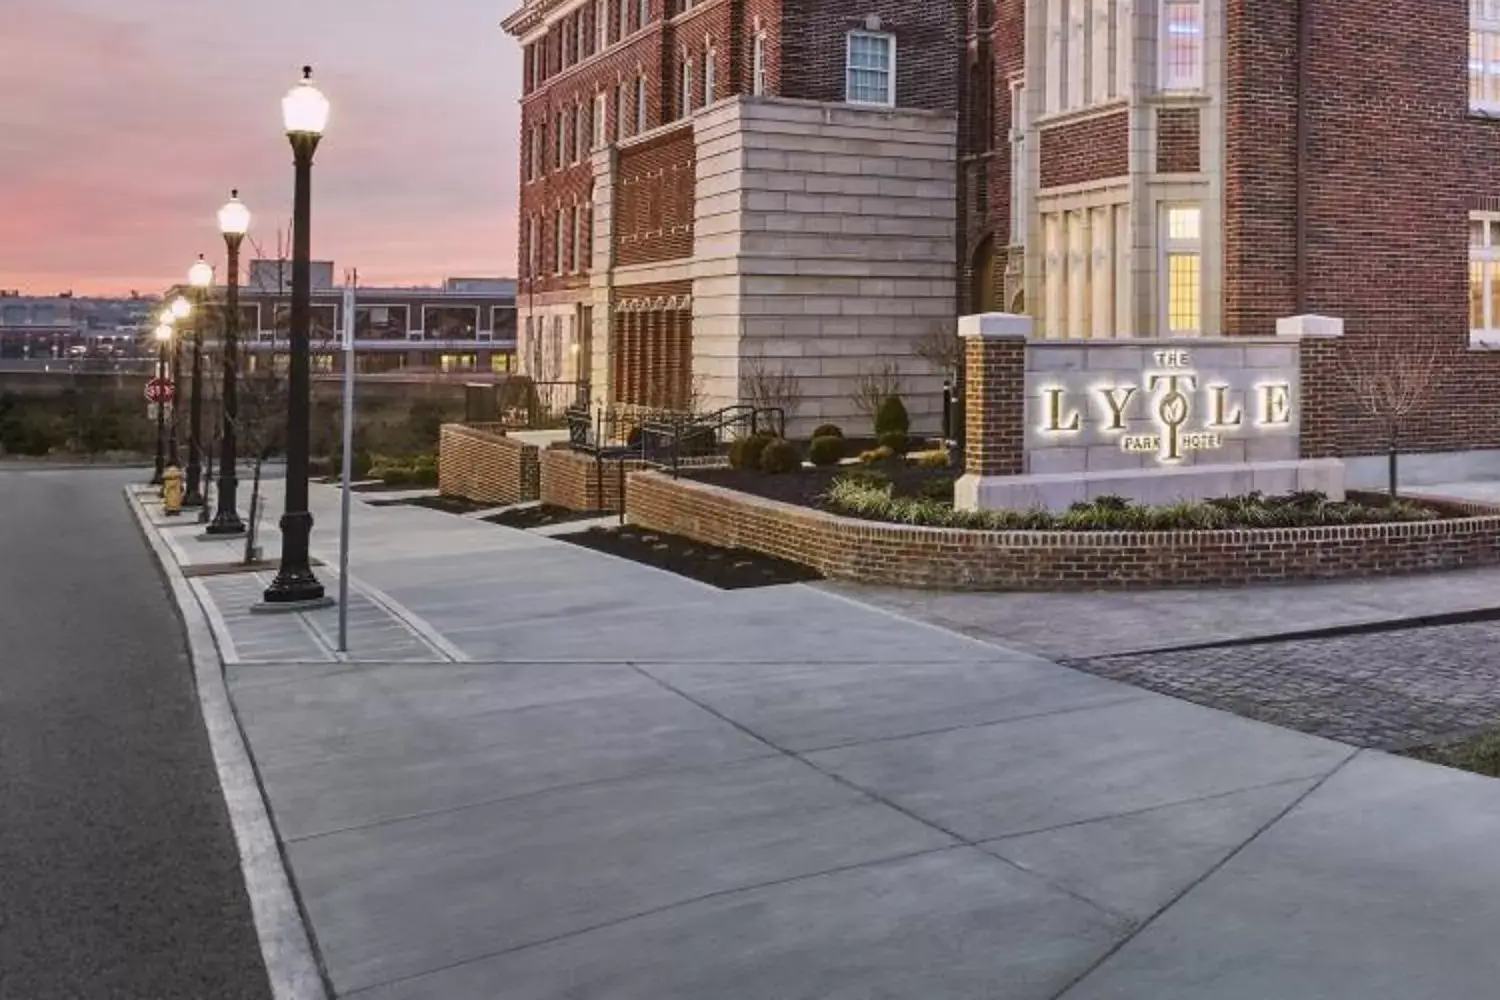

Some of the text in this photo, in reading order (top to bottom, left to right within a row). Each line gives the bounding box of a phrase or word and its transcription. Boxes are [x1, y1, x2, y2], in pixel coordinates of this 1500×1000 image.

[1154, 352, 1190, 366] THE
[1042, 374, 1291, 458] LYTLE
[1124, 433, 1222, 450] PARK HOTEL
